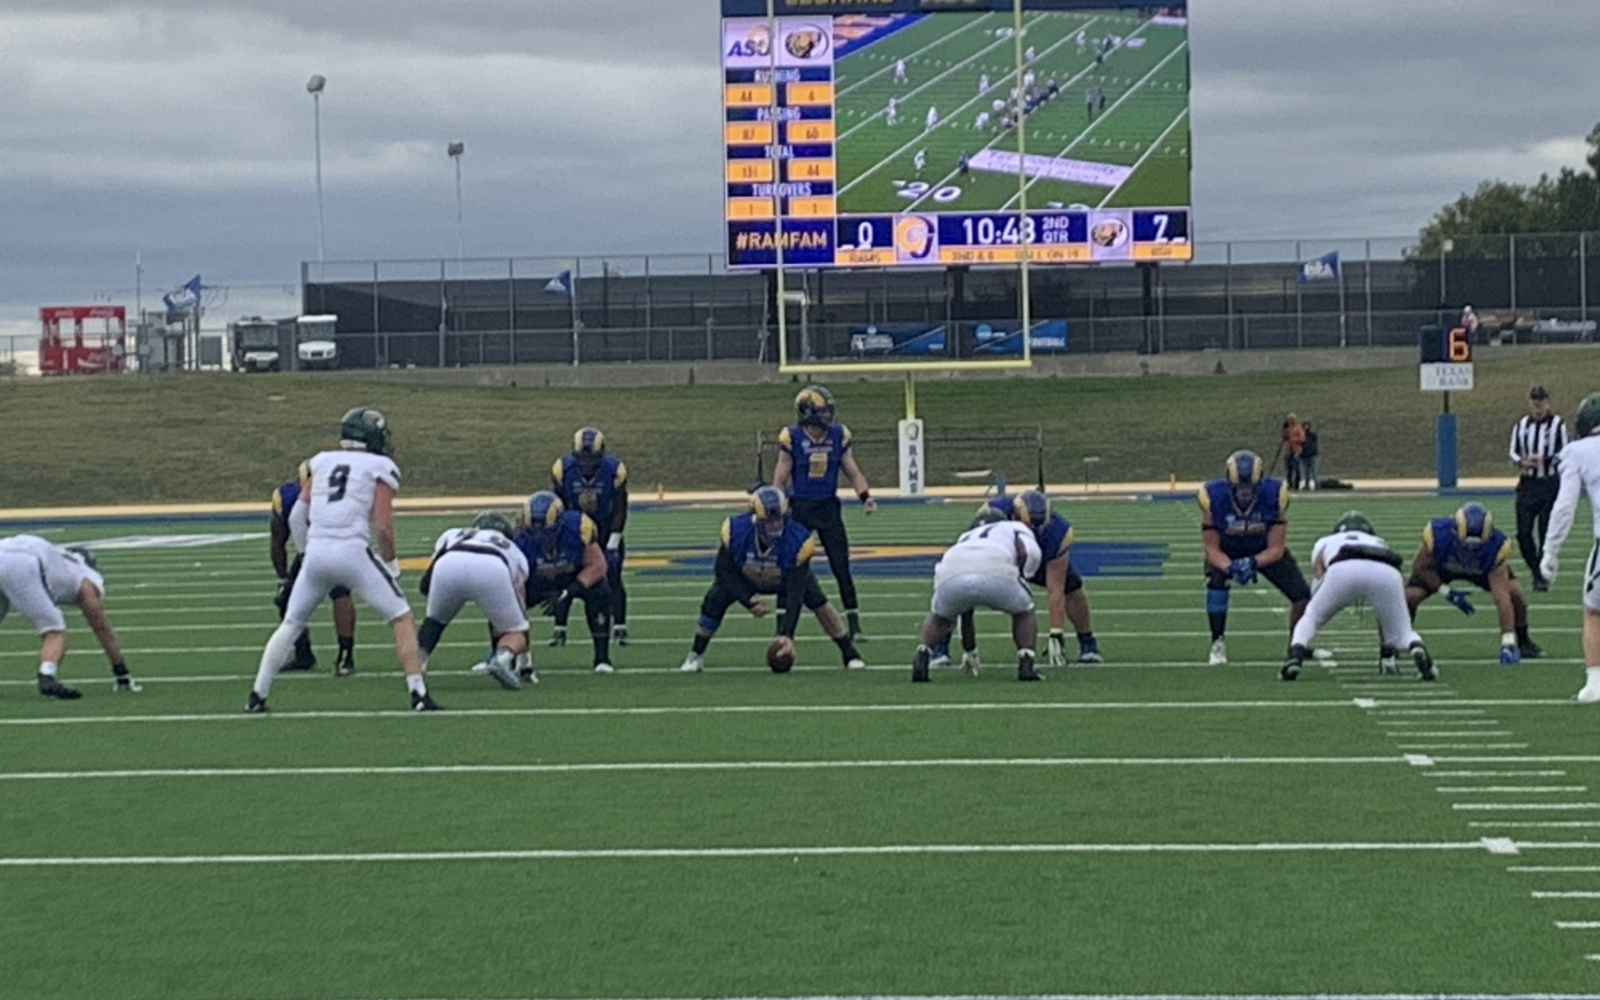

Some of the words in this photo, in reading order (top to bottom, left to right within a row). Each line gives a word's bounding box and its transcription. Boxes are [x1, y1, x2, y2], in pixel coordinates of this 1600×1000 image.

[752, 182, 812, 196] TUROVERS
[1041, 216, 1070, 230] 2ND
[1042, 230, 1069, 244] QTR
[1449, 328, 1469, 360] 6
[908, 444, 919, 495] RAMS
[328, 464, 351, 504] 9
